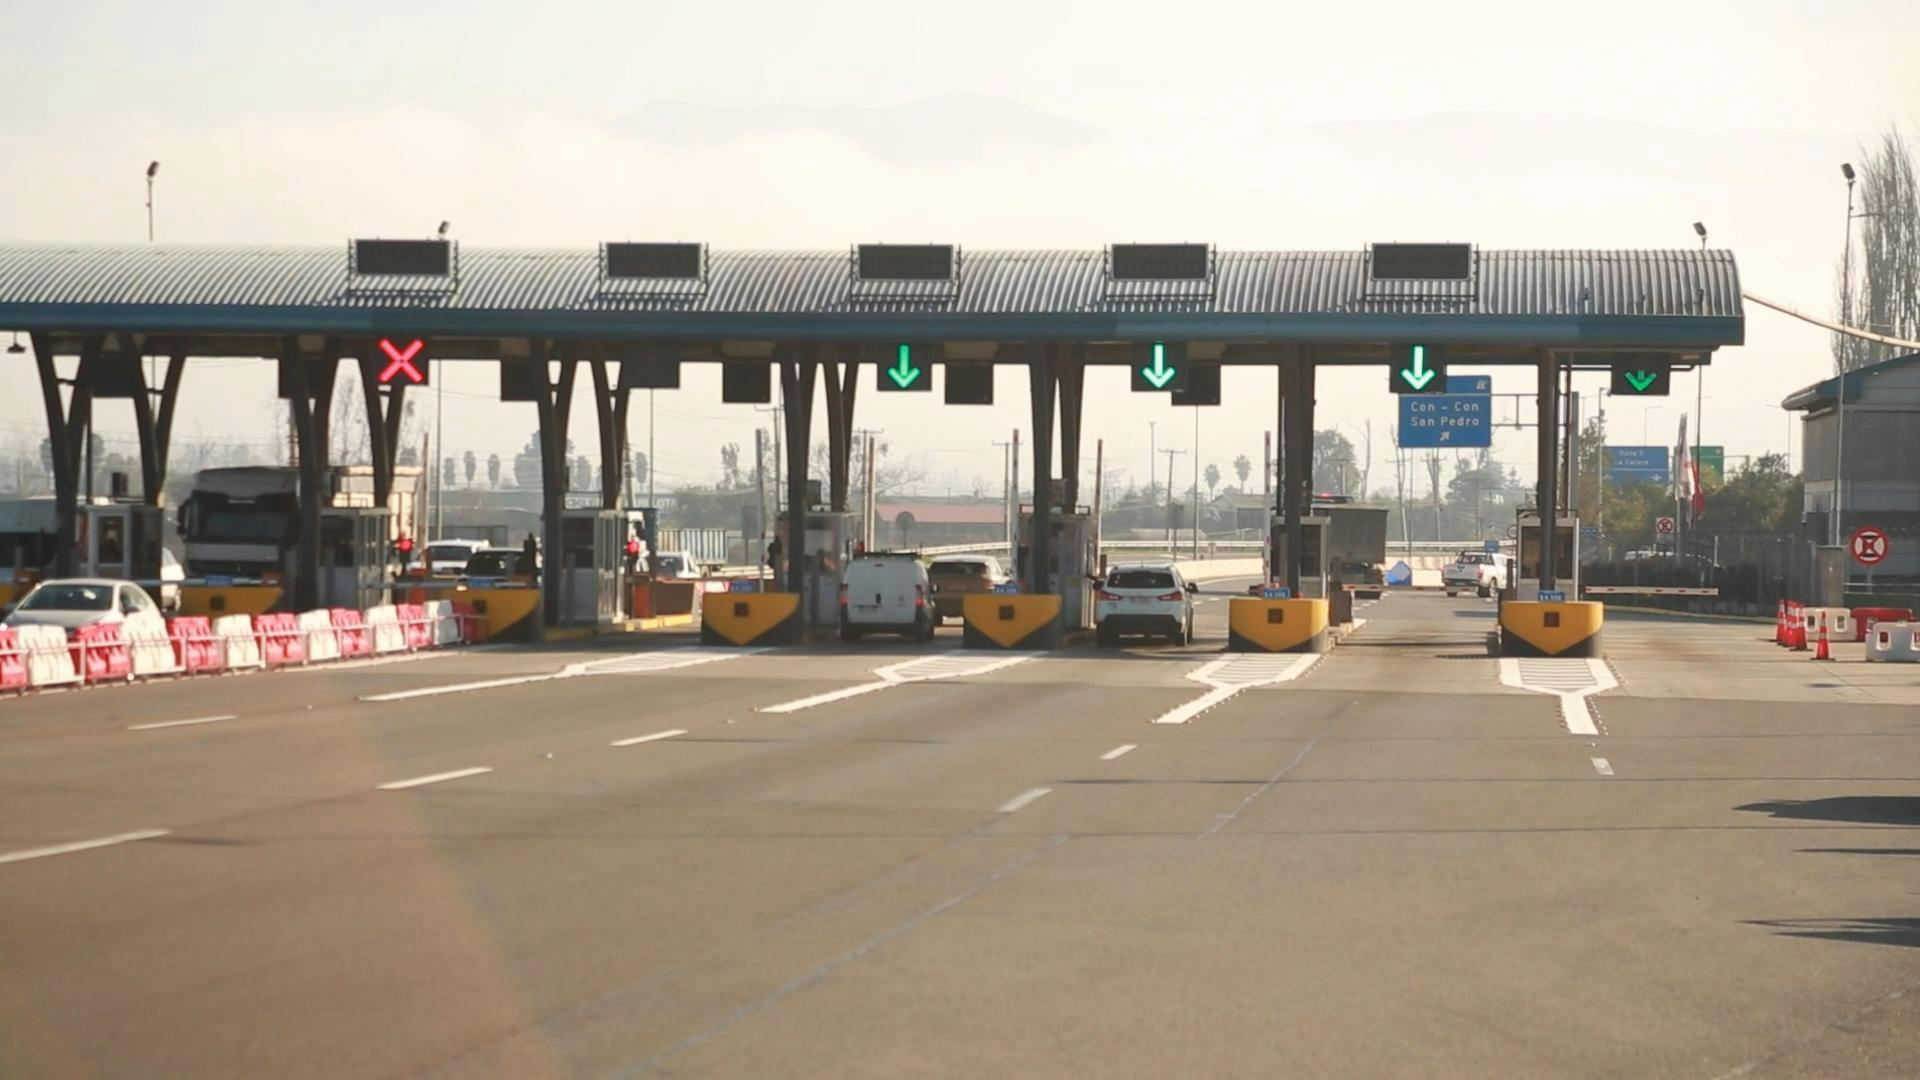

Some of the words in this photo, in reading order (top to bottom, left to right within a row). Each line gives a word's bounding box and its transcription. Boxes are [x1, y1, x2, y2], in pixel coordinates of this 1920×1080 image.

[1411, 401, 1435, 411] Con
[1454, 401, 1479, 411] Con
[1411, 417, 1435, 426] San
[1440, 416, 1480, 426] Pedro
